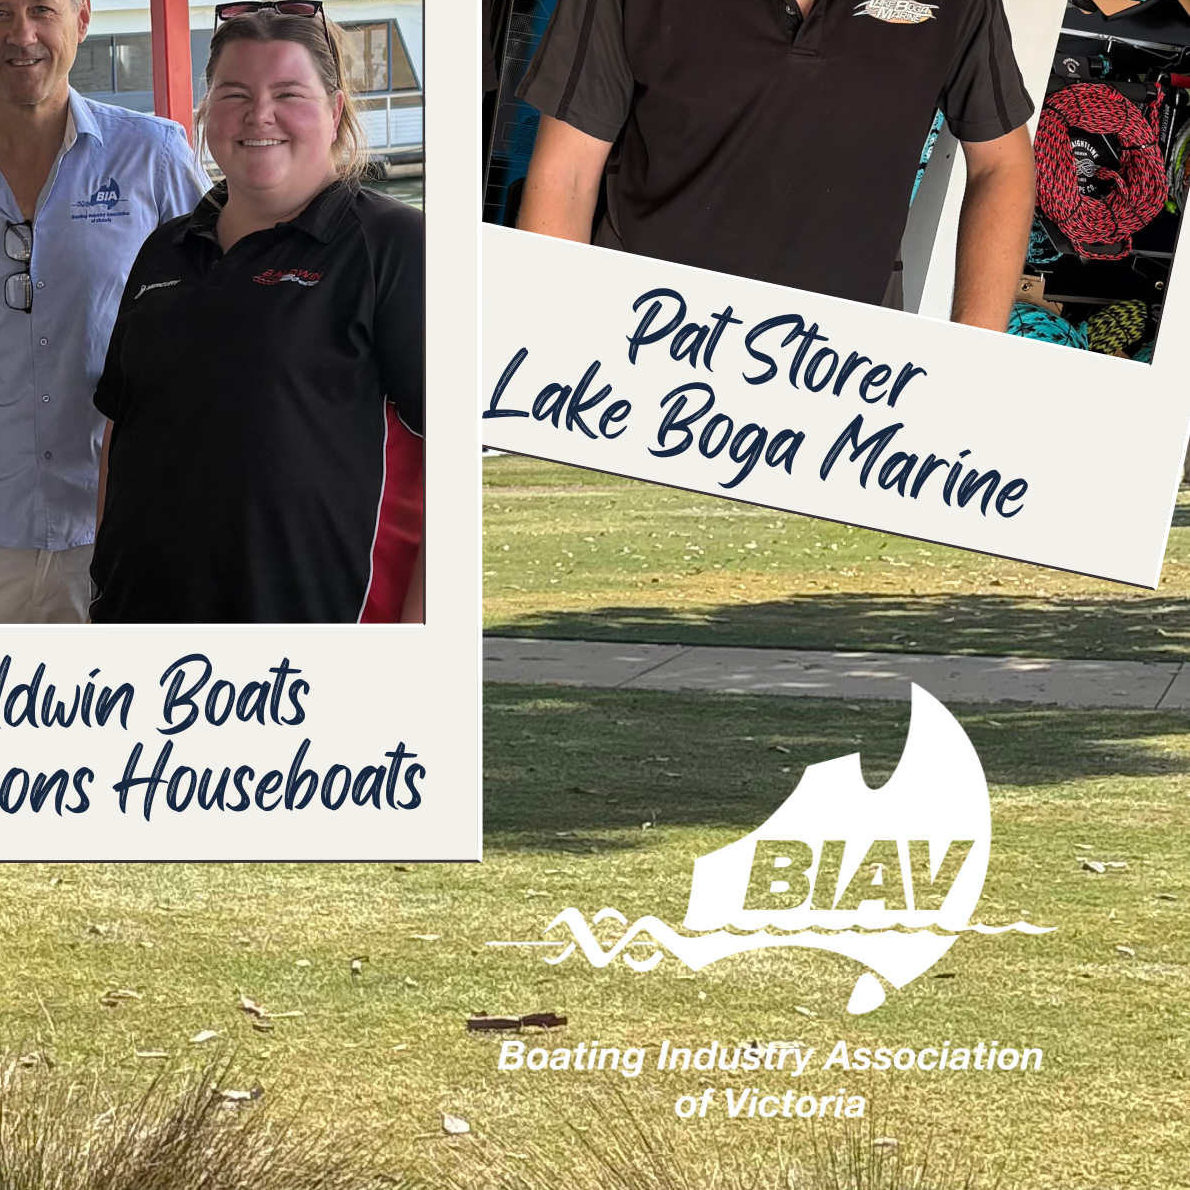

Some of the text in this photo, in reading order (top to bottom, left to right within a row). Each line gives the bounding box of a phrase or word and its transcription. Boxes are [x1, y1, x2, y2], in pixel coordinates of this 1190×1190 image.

[876, 7, 921, 24] MARINE
[894, 0, 930, 15] BOGA
[1071, 139, 1100, 159] AIGHTLINE
[96, 191, 118, 202] BIA
